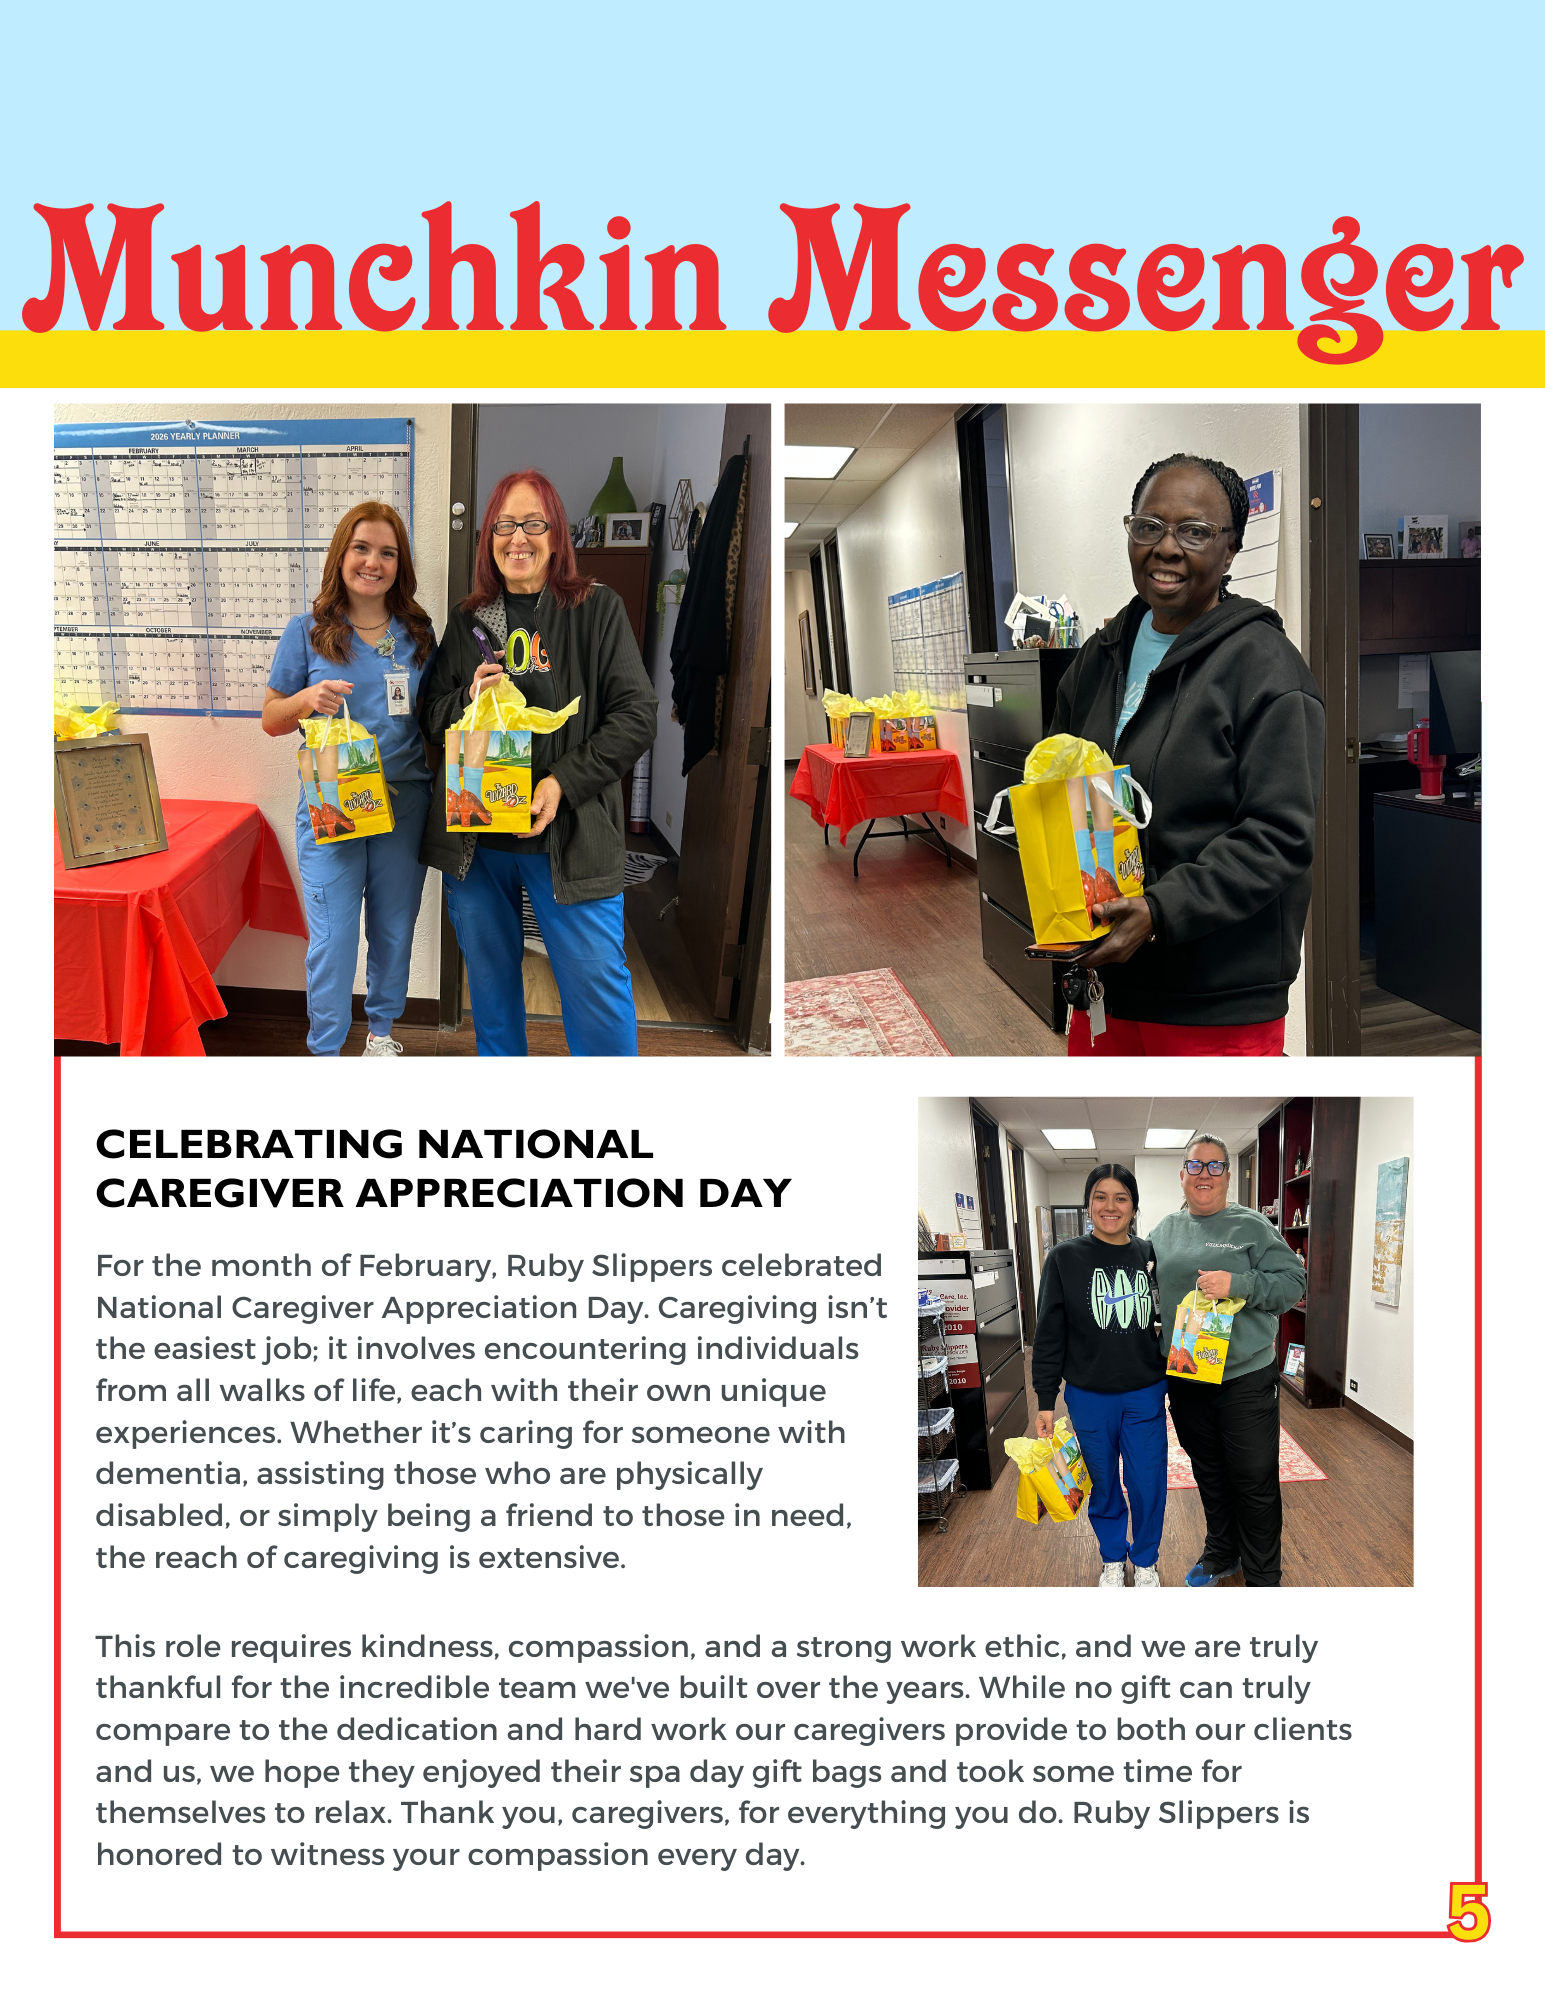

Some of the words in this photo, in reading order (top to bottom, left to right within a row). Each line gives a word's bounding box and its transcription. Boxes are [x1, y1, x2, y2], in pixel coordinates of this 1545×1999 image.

[150, 433, 169, 441] 2026
[170, 432, 201, 441] YEARLY
[202, 431, 240, 440] PLANNER
[485, 783, 518, 803] WIZARD
[940, 1293, 957, 1301] Care,
[945, 1304, 970, 1312] ovider
[949, 1377, 967, 1385] 2010
